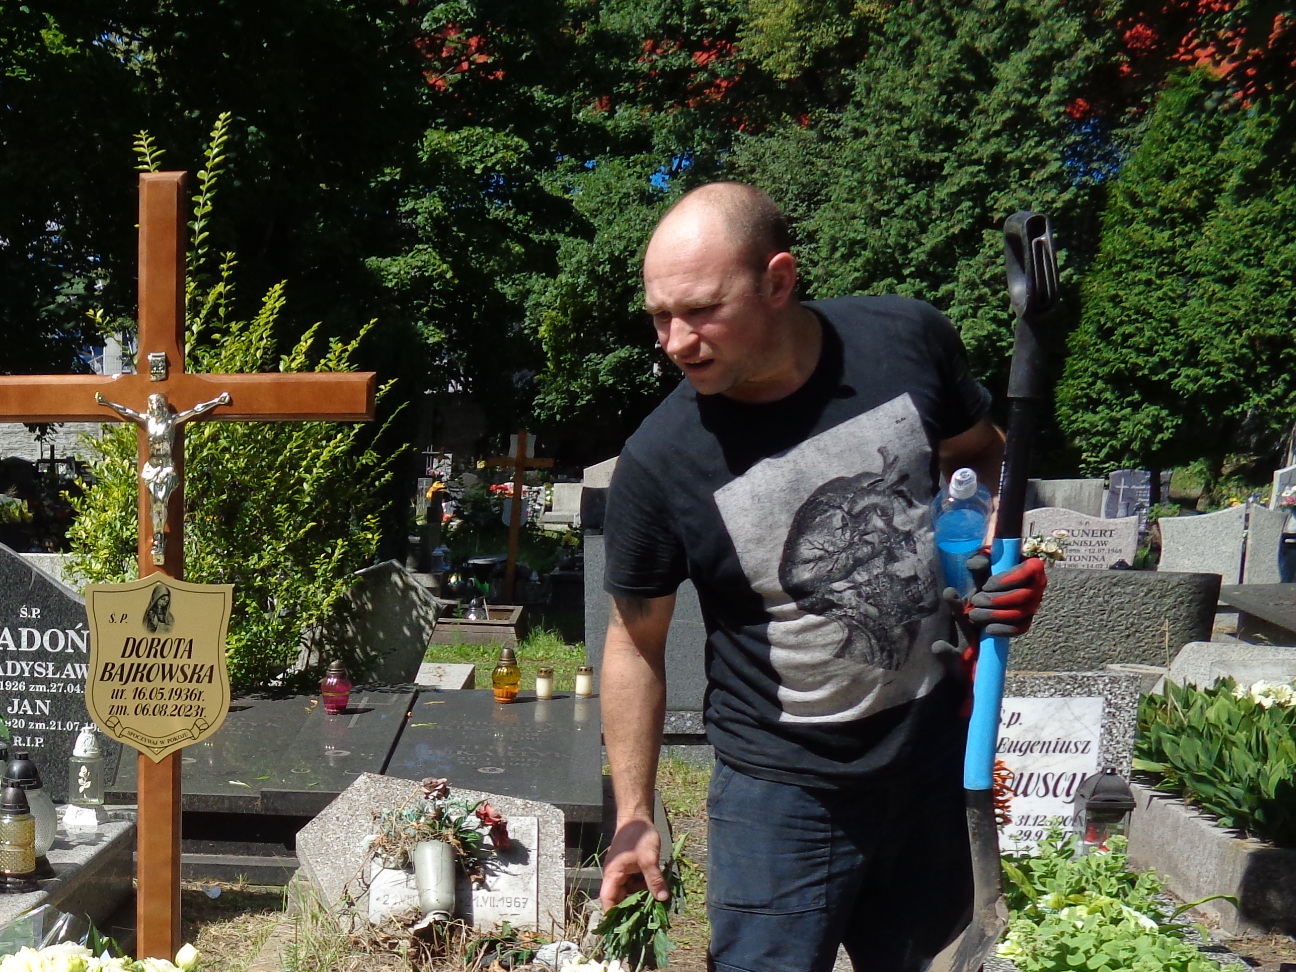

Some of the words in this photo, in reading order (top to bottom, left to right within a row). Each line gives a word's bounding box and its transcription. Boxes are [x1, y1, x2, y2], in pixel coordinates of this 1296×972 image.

[120, 636, 195, 660] DOROTA
[99, 661, 215, 686] BAJKOWSKA
[110, 687, 128, 700] ur.
[132, 686, 206, 702] 16.05.1936r.
[6, 698, 52, 716] JAN
[107, 704, 131, 717] zm.
[134, 704, 208, 719] 06.08.2023r.
[13, 735, 45, 748] R.I.P.
[996, 737, 1092, 757] Eugeniusz
